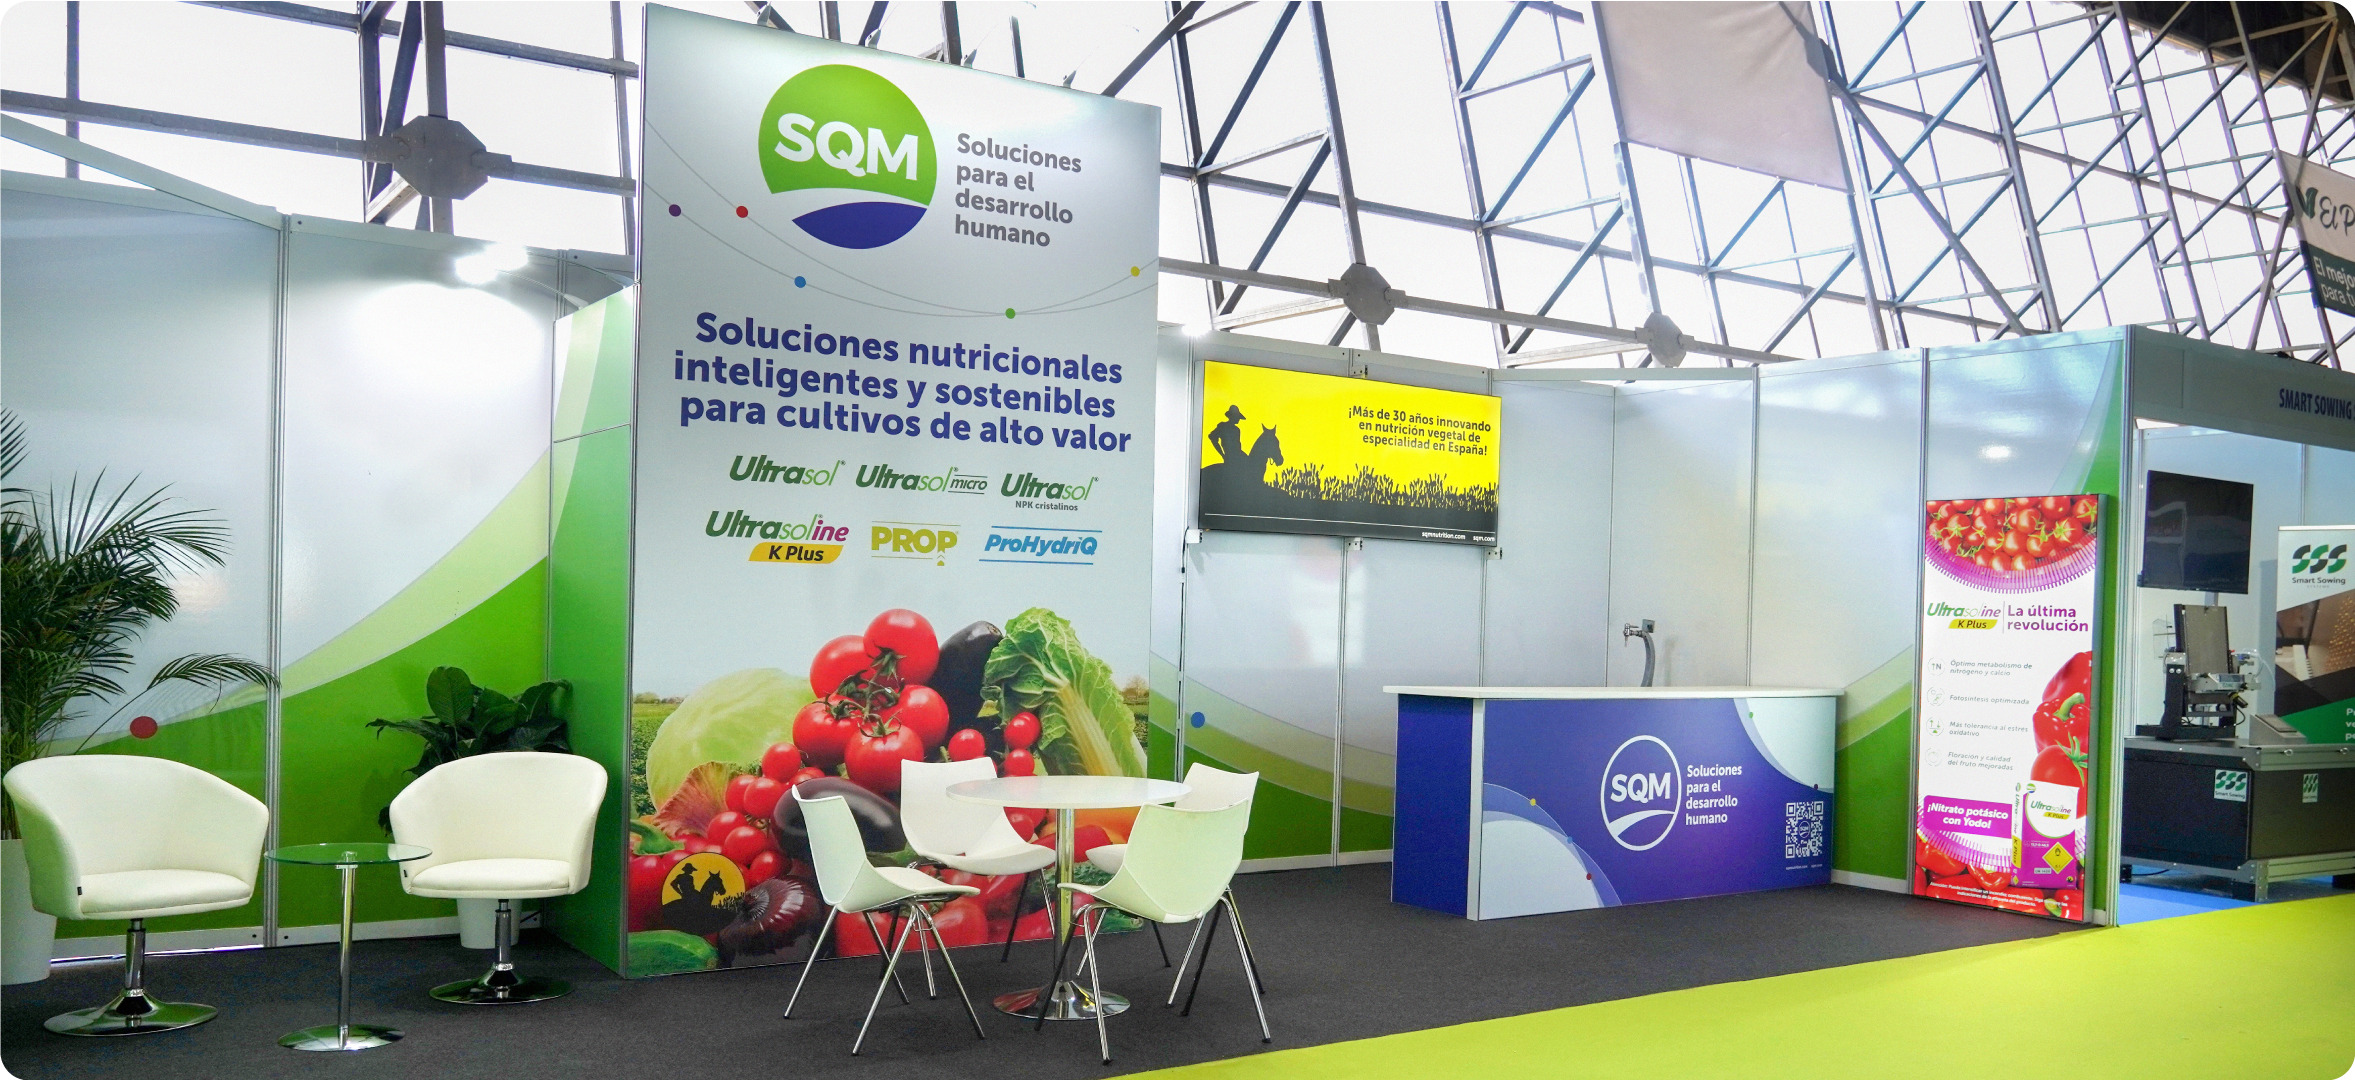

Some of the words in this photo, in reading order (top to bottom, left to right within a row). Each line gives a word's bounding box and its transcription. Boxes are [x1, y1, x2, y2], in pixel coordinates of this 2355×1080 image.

[774, 112, 919, 181] SQM
[957, 133, 1082, 173] Soluciones
[956, 163, 1008, 188] para
[1014, 171, 1035, 192] el
[955, 189, 1074, 225] desarrollo
[955, 214, 1051, 247] humano
[2313, 256, 2326, 277] El
[2326, 266, 2355, 291] mejo
[2321, 283, 2347, 304] para
[696, 312, 899, 362] Soluciones
[909, 340, 1122, 384] nutricionales
[675, 351, 898, 399] inteligentes
[907, 380, 928, 409] y
[935, 381, 1116, 419] sostenibles
[2279, 388, 2313, 413] SMART
[2314, 395, 2351, 420] SOWING
[680, 394, 766, 427] para
[776, 398, 921, 437] cultivos
[930, 411, 971, 441] de
[979, 415, 1044, 447] alto
[1052, 423, 1132, 453] valor
[1349, 405, 1374, 420] ¡Más
[1377, 408, 1390, 420] de
[1393, 410, 1406, 422] 30
[1409, 412, 1434, 425] años
[1436, 414, 1491, 432] innovando
[1359, 422, 1372, 432] en
[1375, 421, 1425, 437] nutrición
[1427, 428, 1466, 444] vegetal
[1468, 431, 1481, 443] de
[1362, 433, 1431, 450] especialidad
[1433, 440, 1446, 451] en
[1448, 441, 1488, 456] España!
[729, 455, 841, 486] Ultrasol
[856, 464, 954, 492] Ultrasol
[950, 477, 988, 491] micro
[1000, 473, 1094, 501] Ultrasol
[1015, 501, 1034, 509] NPK
[1035, 502, 1078, 511] cristalinos
[705, 510, 850, 542] Ultrasoline
[1421, 531, 1466, 541] sqmnutrition.com
[871, 526, 957, 554] PROP
[984, 534, 1098, 557] ProHydriQ
[768, 545, 781, 560] K
[785, 546, 824, 562] Plus
[2317, 577, 2346, 585] Sowing
[2008, 605, 2024, 617] La
[2028, 605, 2077, 618] última
[1957, 620, 1965, 628] K
[1966, 620, 1987, 629] Plus
[2007, 619, 2089, 632] revolución
[1977, 660, 2022, 669] metabolismo
[1990, 697, 2030, 705] optimizada
[1949, 729, 1980, 737] oxidativo
[1964, 722, 1998, 730] tolerancia
[1977, 762, 2013, 770] mejoradas
[1985, 755, 2012, 763] calidad
[1687, 764, 1742, 778] Soluciones
[1610, 772, 1671, 804] SQM
[1686, 782, 1709, 796] para
[1711, 780, 1721, 792] el
[1685, 795, 1738, 809] desarrollo
[1927, 802, 1965, 816] ¡Nitrato
[1965, 805, 2009, 822] potásico
[1685, 811, 1728, 826] humano
[1942, 815, 1962, 825] con
[1963, 816, 1992, 829] Yodo!
